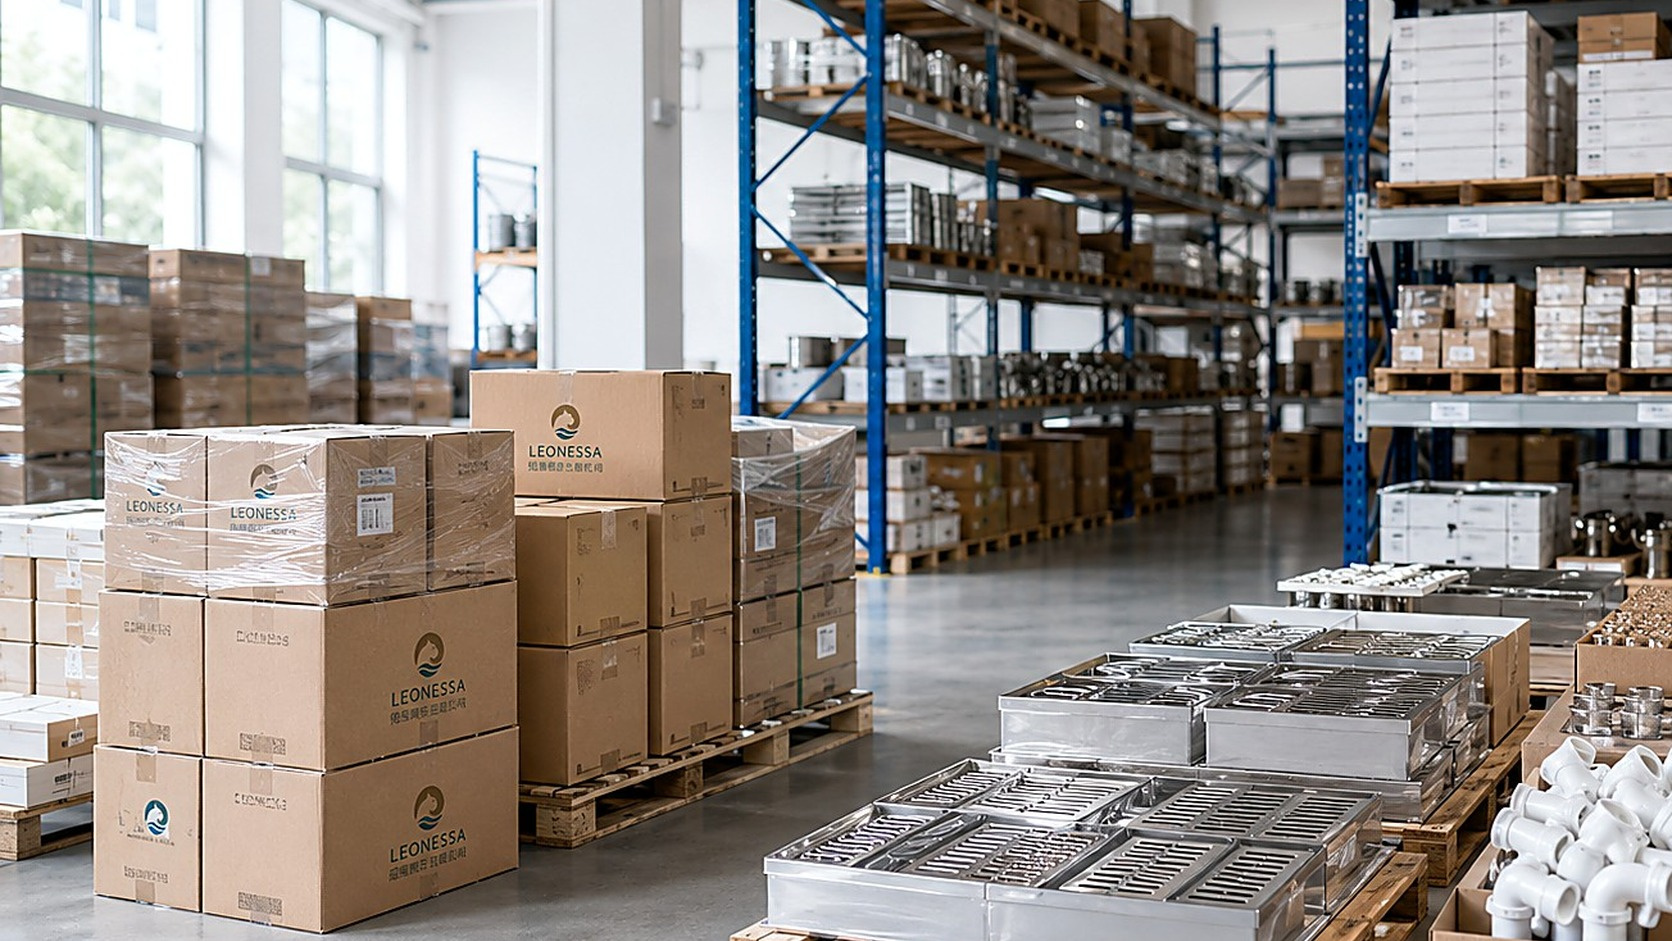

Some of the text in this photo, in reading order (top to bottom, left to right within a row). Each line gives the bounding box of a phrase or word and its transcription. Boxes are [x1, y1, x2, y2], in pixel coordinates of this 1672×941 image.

[529, 445, 602, 458] LEONESSA
[126, 500, 183, 514] LEONESSA
[231, 506, 297, 520] LEONESSA
[391, 679, 466, 707] LEONESSA
[390, 828, 466, 863] LEONESSA
